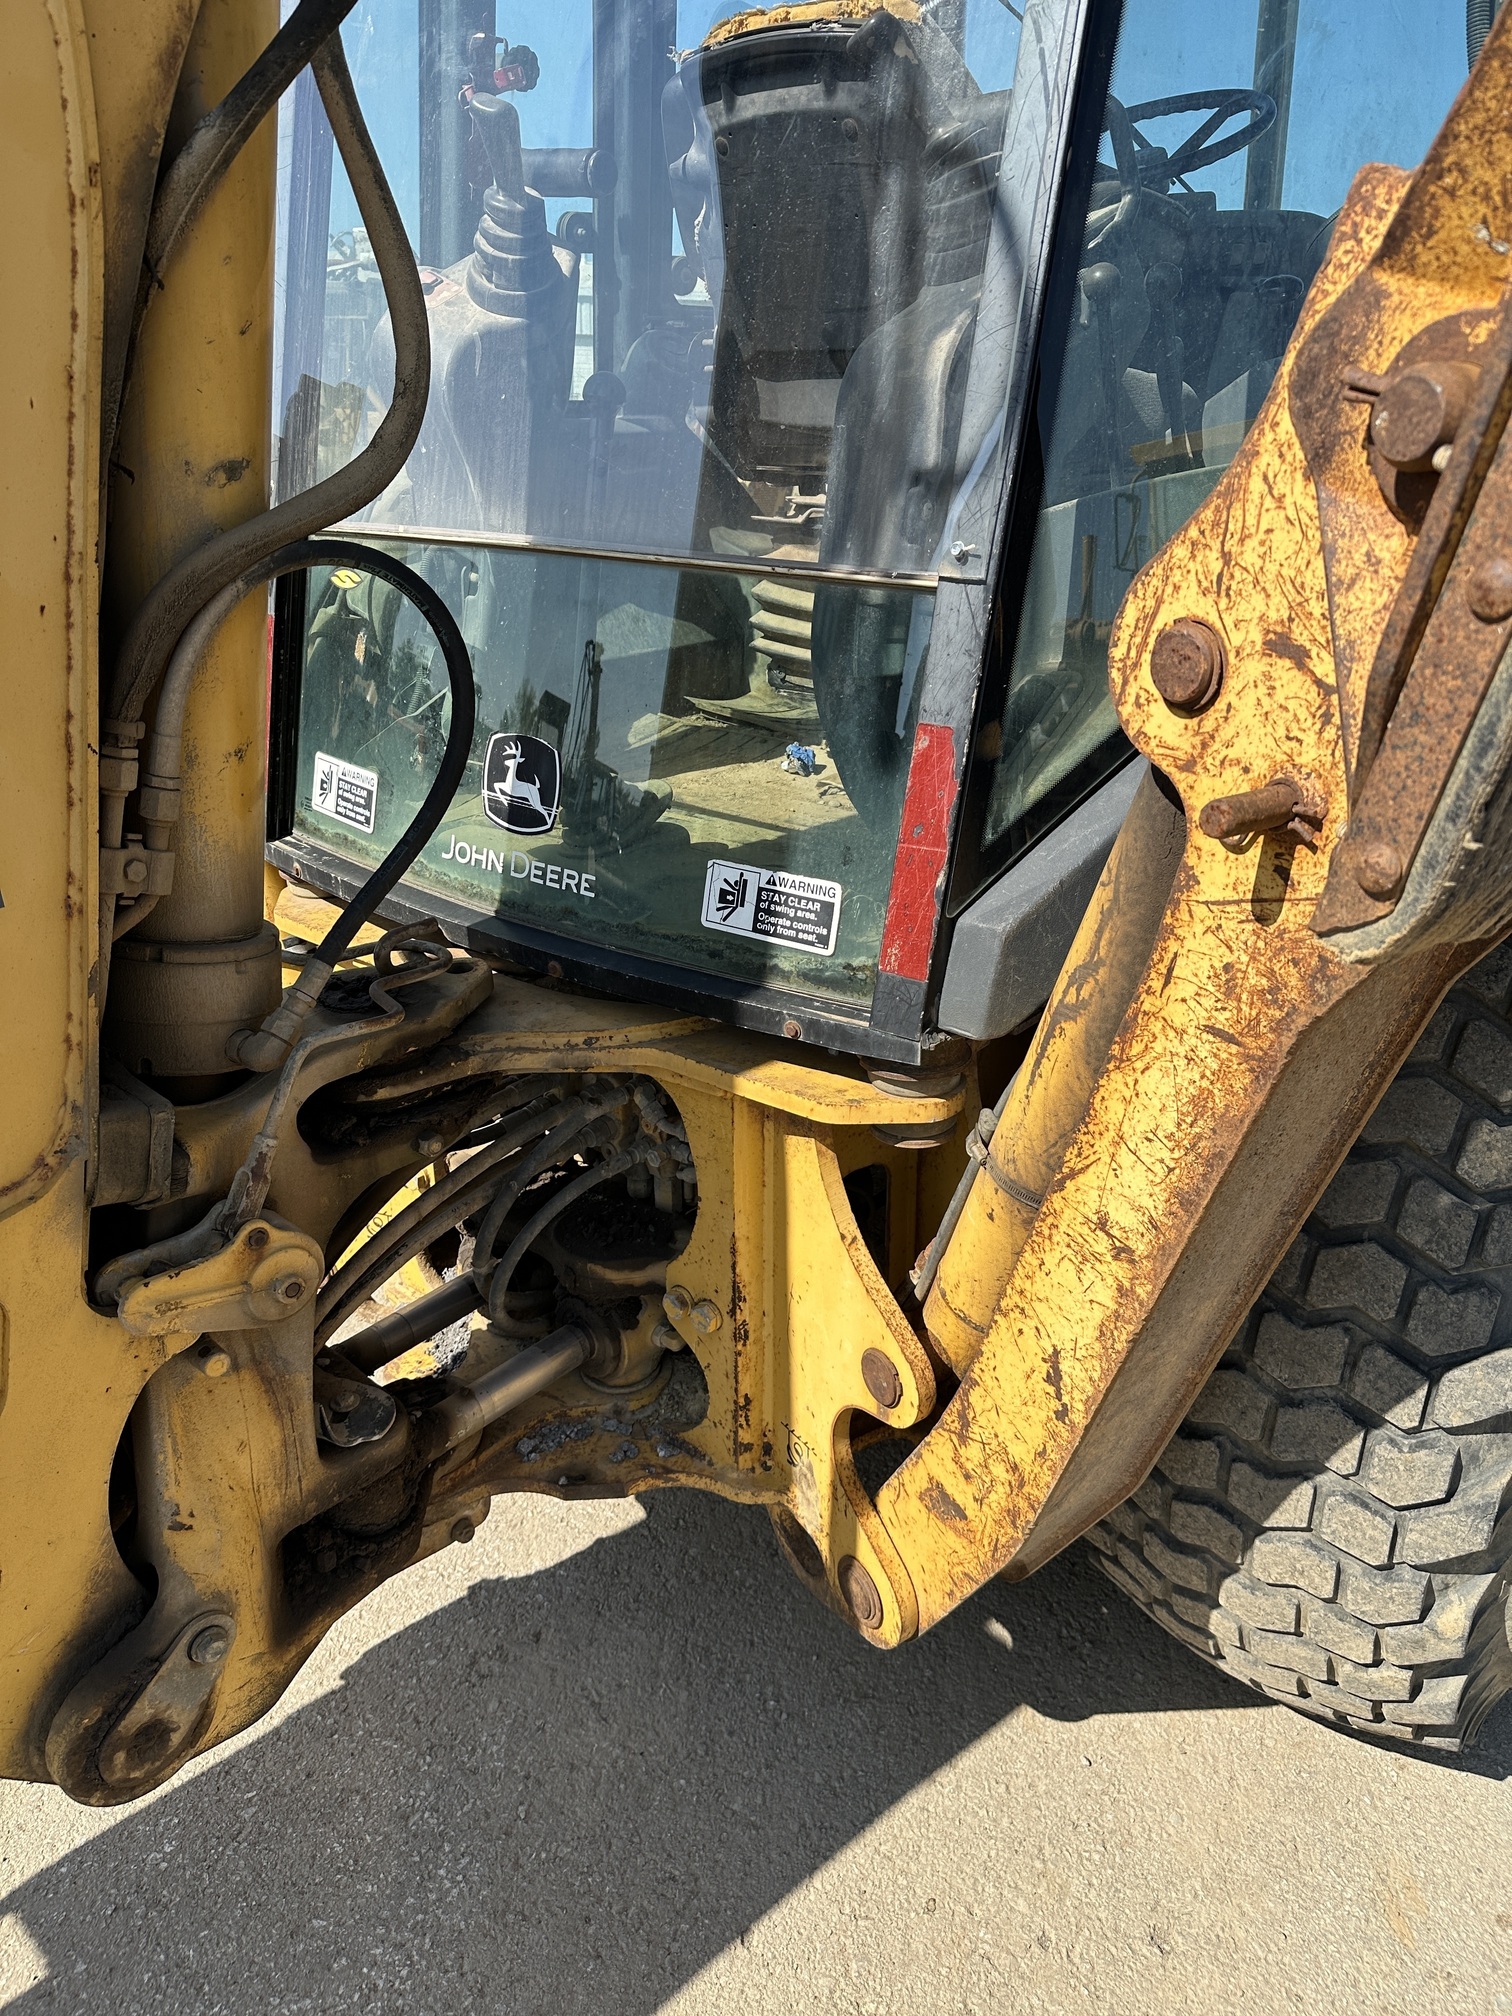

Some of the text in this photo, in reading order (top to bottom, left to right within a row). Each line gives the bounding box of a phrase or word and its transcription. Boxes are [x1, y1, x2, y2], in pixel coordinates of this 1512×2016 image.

[339, 780, 368, 798] STAY CLEAR
[346, 770, 375, 788] WARNING
[442, 834, 597, 898] JOHN DEERE
[778, 876, 837, 899] WARNING
[759, 901, 818, 921] of swing area.
[761, 891, 821, 912] STAY CLEAR
[756, 922, 819, 943] only from seat.
[758, 912, 828, 936] Operate controls
